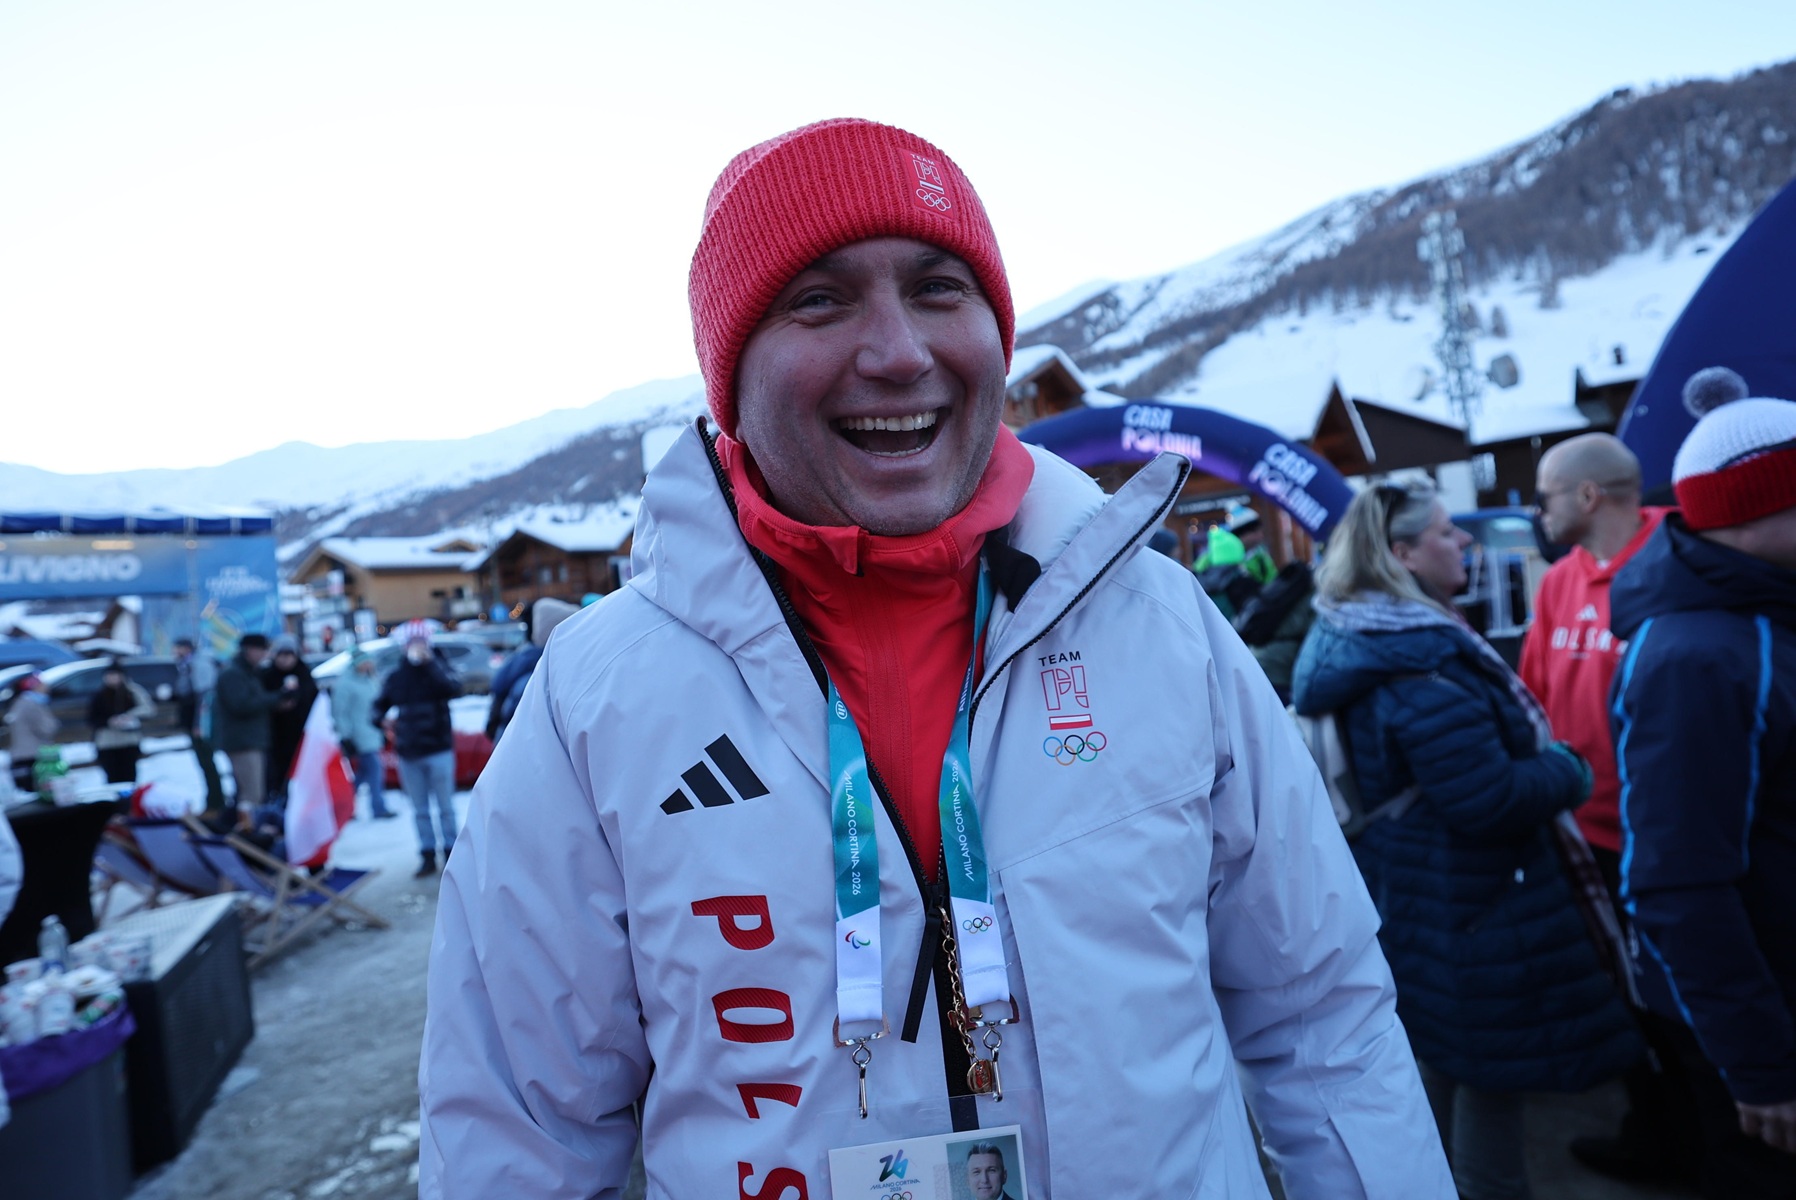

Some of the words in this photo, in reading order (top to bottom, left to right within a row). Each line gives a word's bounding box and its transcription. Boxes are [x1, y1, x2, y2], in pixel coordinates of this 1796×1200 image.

[911, 153, 935, 166] TEAM
[1123, 404, 1174, 431] CASA
[1264, 443, 1318, 489] CASA
[1038, 650, 1082, 667] TEAM
[844, 770, 856, 818] MILANO
[953, 784, 965, 833] CORTINA
[848, 820, 860, 869] CORTINA
[958, 834, 975, 882] MILANO
[851, 871, 861, 896] 2026
[870, 1182, 895, 1191] MILANO
[895, 1179, 921, 1187] CORTINA
